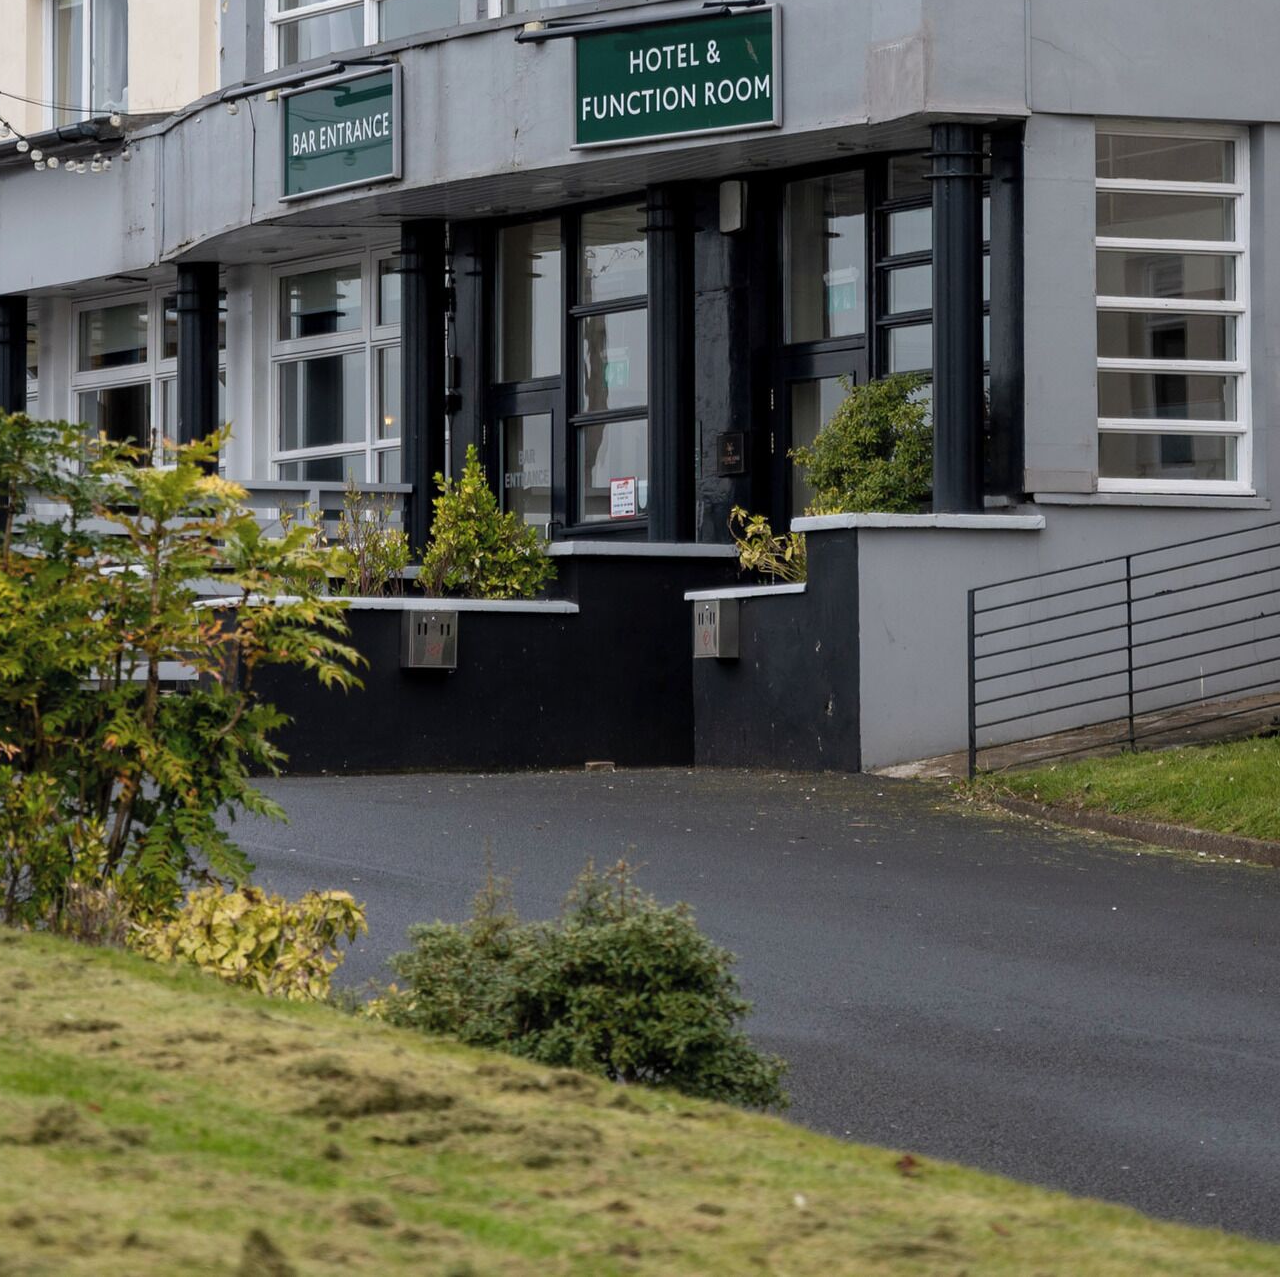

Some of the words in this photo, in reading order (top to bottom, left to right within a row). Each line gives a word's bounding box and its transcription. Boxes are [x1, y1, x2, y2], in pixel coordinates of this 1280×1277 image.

[629, 42, 700, 74] HOTEL
[706, 39, 721, 64] &
[582, 84, 696, 121] FUNCTION
[704, 74, 771, 106] ROOM
[292, 129, 317, 156] BAR
[319, 111, 390, 150] ENTRANCE
[518, 449, 536, 465] BAR
